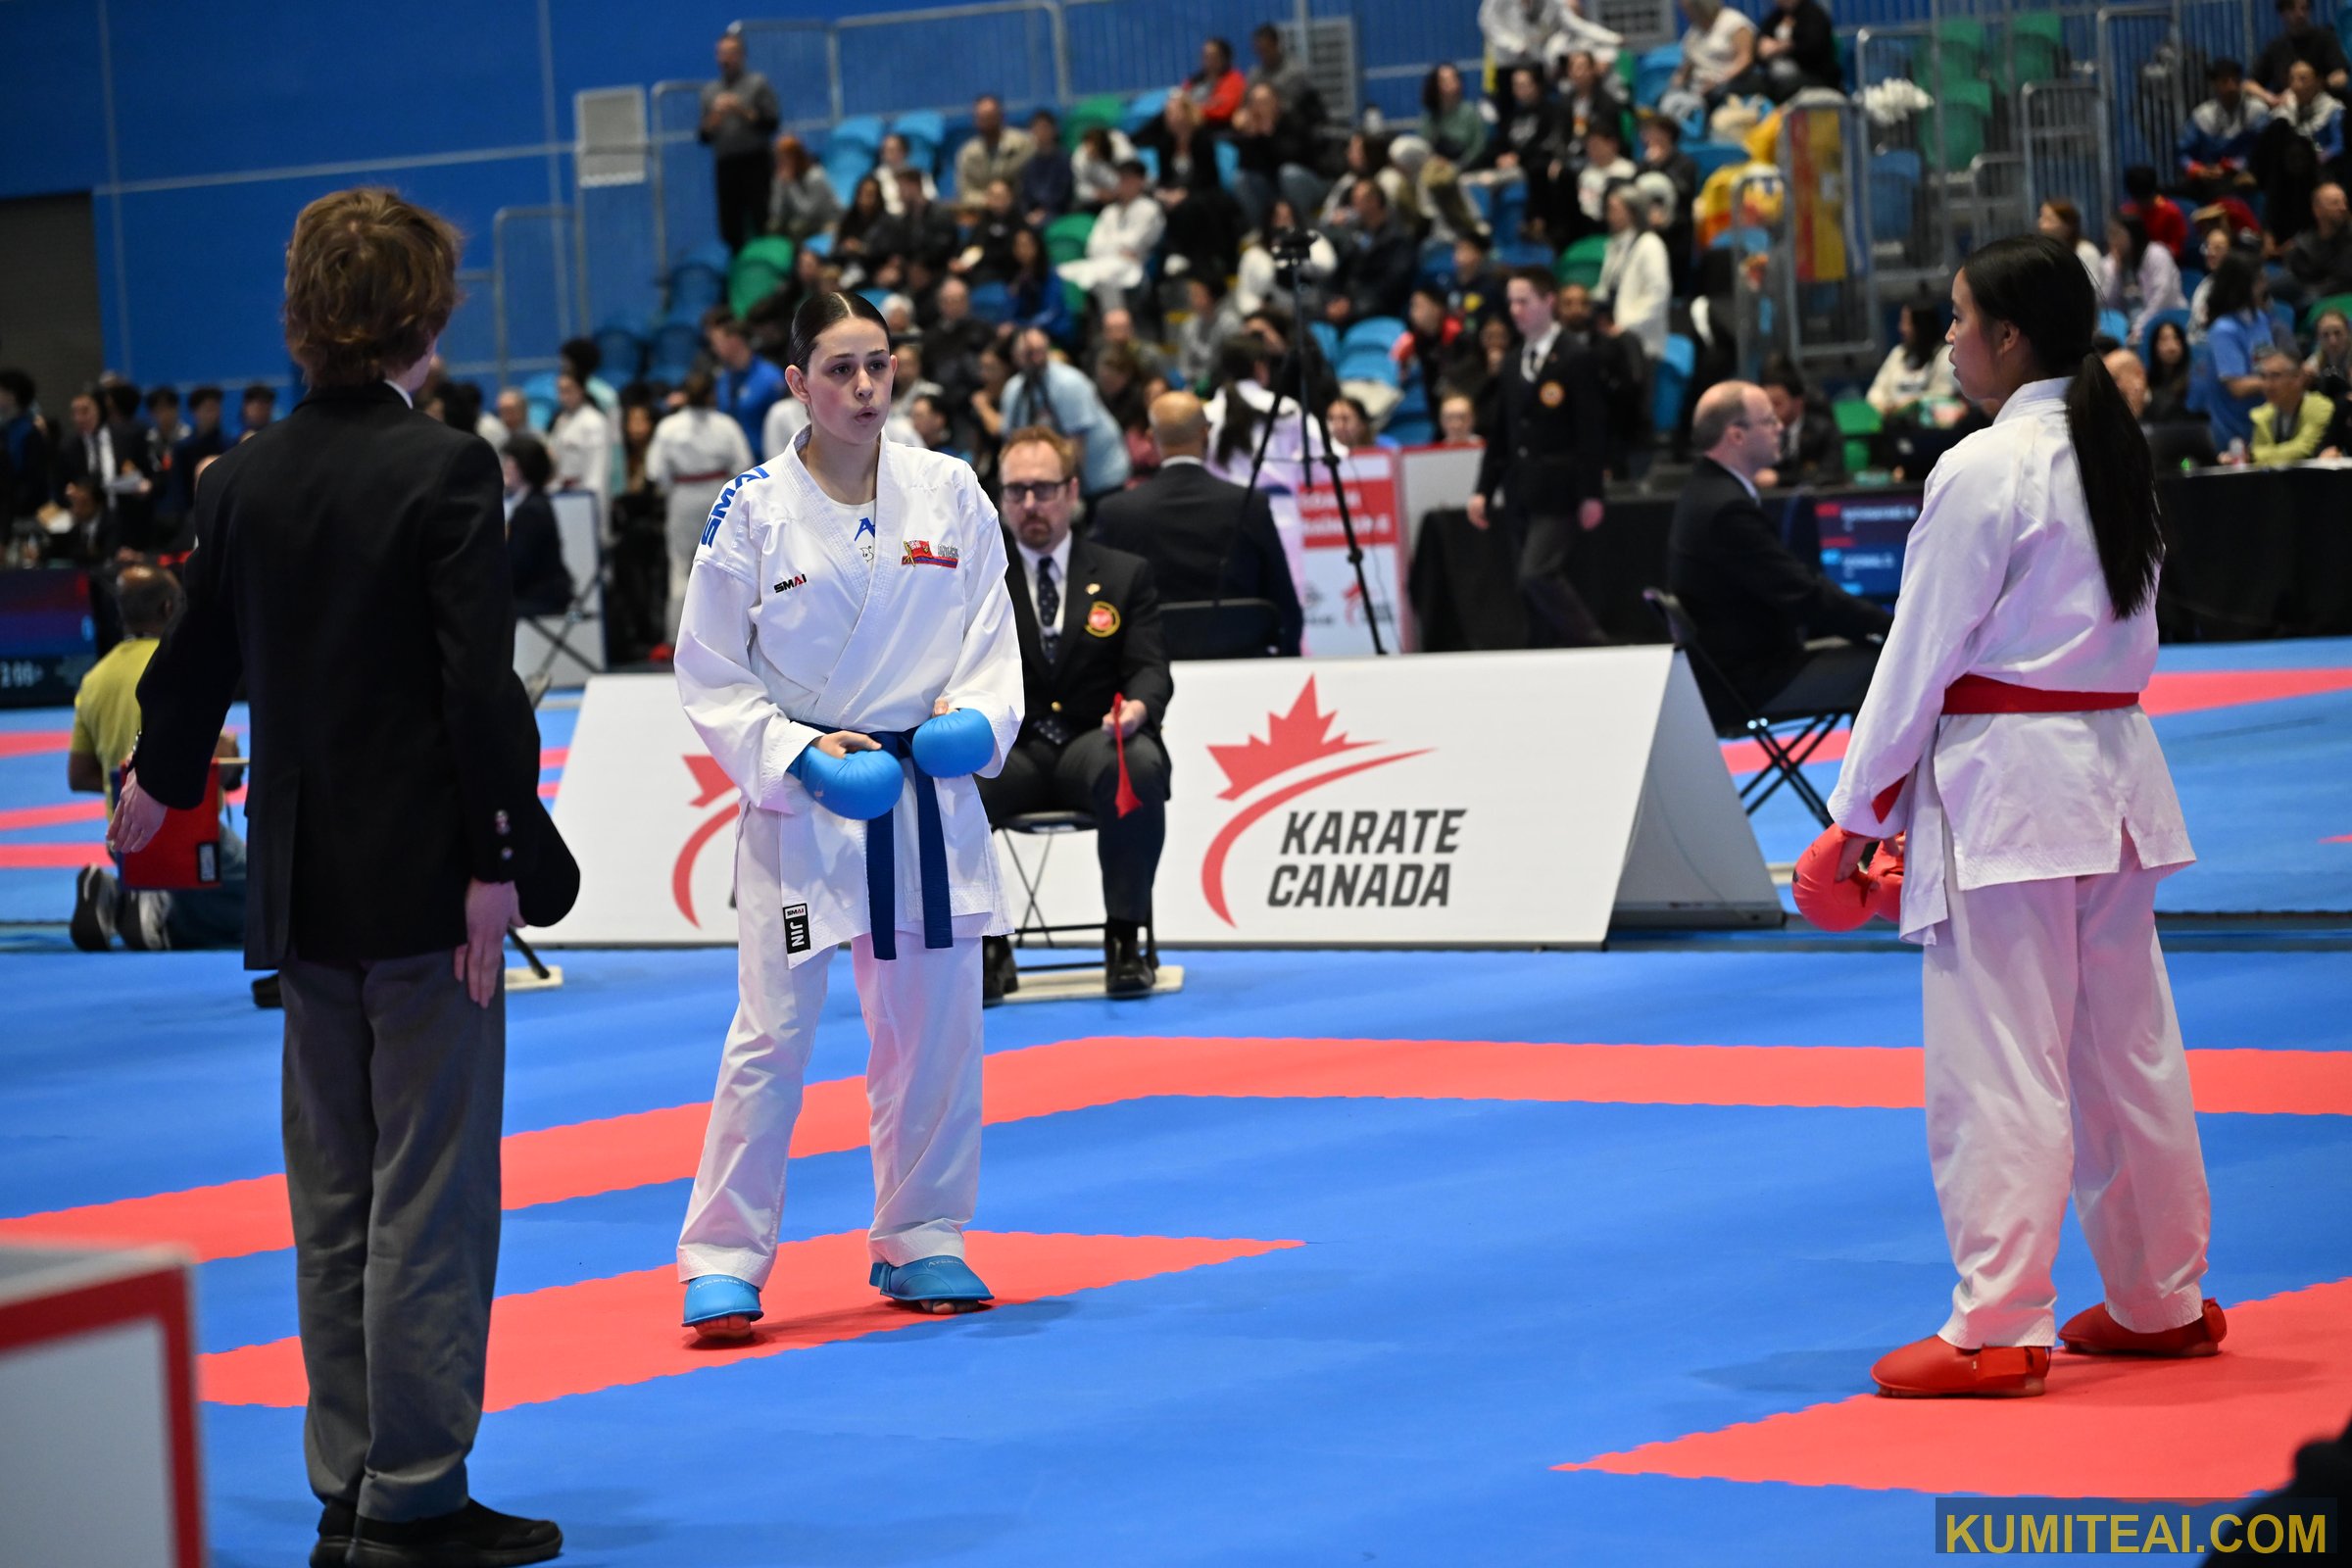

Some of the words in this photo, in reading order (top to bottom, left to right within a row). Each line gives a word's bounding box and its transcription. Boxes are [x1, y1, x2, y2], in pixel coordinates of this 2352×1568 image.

[701, 466, 769, 548] SMAI
[773, 573, 808, 594] SMAI
[1279, 808, 1468, 856] KARATE
[1266, 862, 1451, 907] CANADA
[790, 922, 805, 947] JIN
